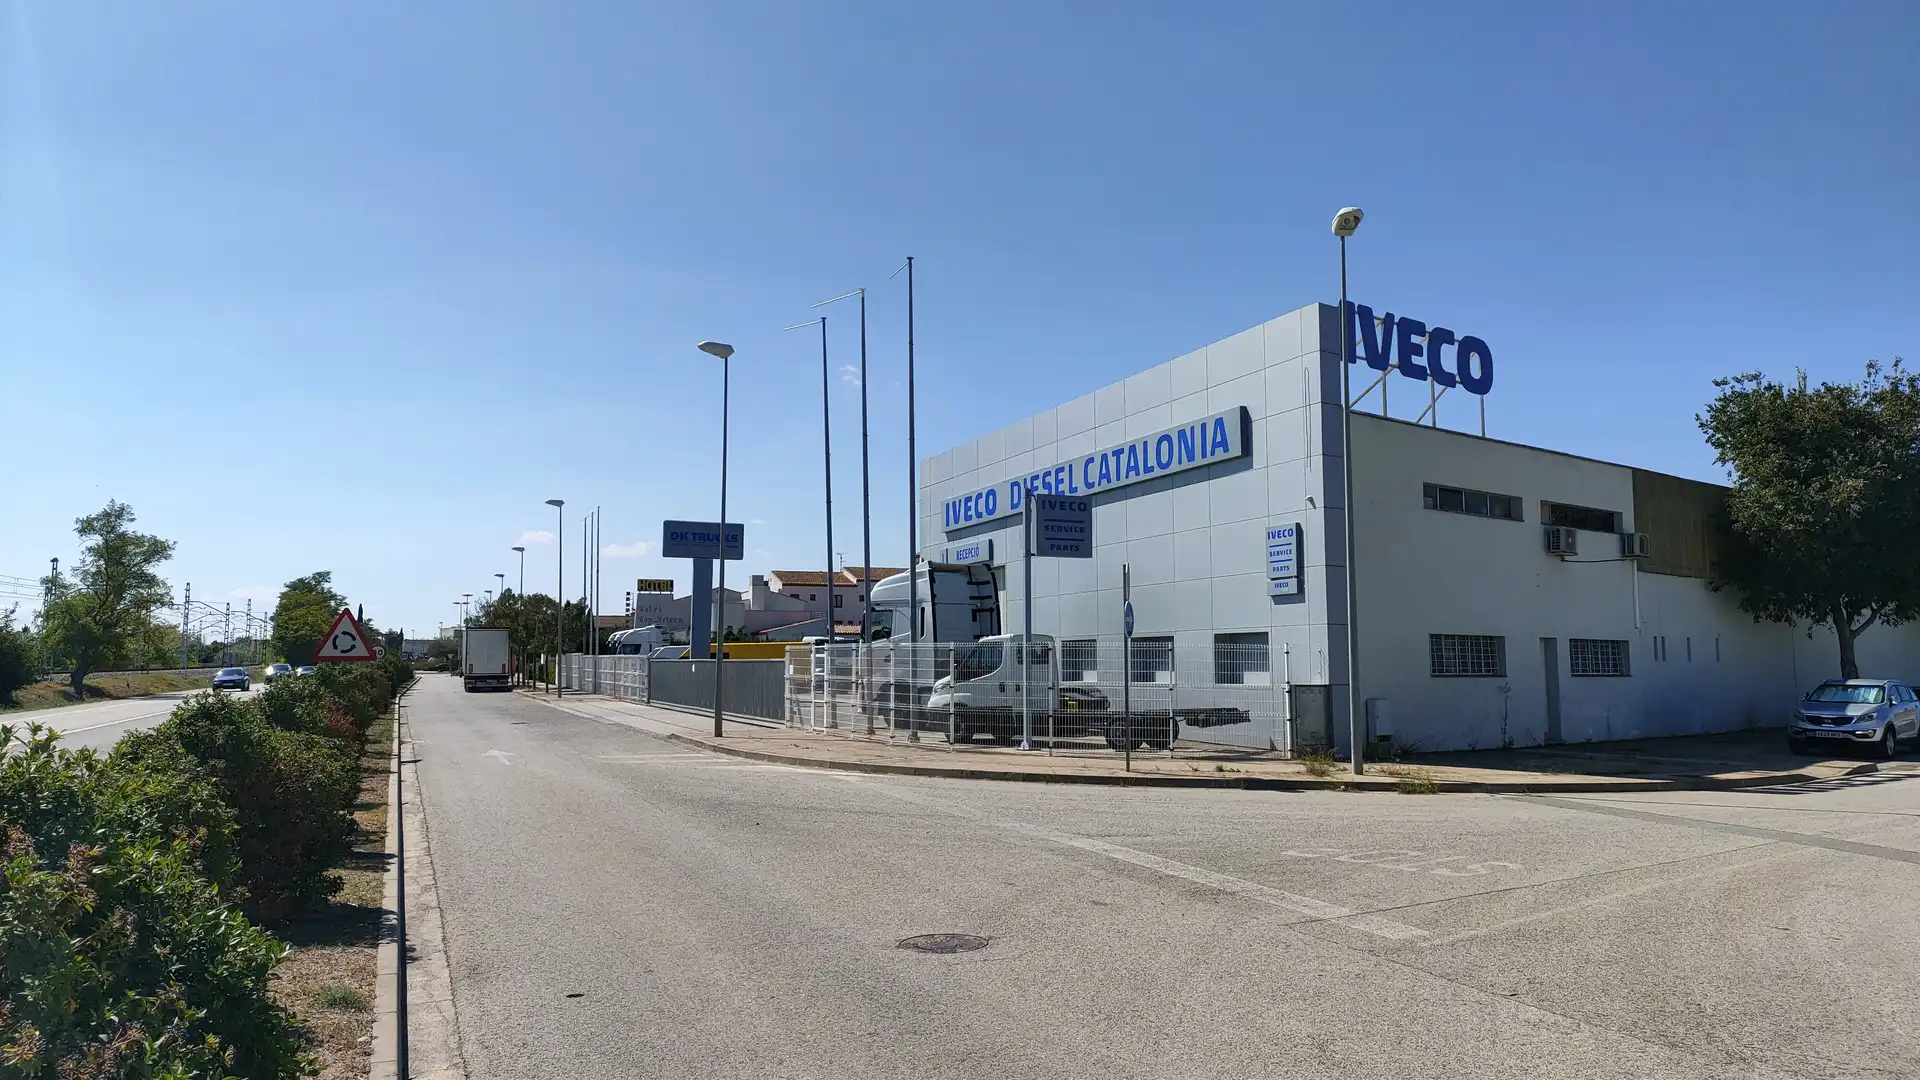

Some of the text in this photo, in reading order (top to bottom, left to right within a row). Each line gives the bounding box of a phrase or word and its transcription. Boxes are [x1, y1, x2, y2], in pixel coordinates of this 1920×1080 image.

[1339, 299, 1493, 395] IVECO
[945, 489, 998, 528] IVECO
[1083, 417, 1230, 489] CATALONIA
[1041, 500, 1088, 512] IVECO
[1044, 525, 1086, 533] SERVICE
[1267, 528, 1294, 540] IVECO
[956, 543, 980, 560] RECEPCIÓ
[1050, 544, 1080, 552] PARTS
[1269, 549, 1293, 557] SERVICE
